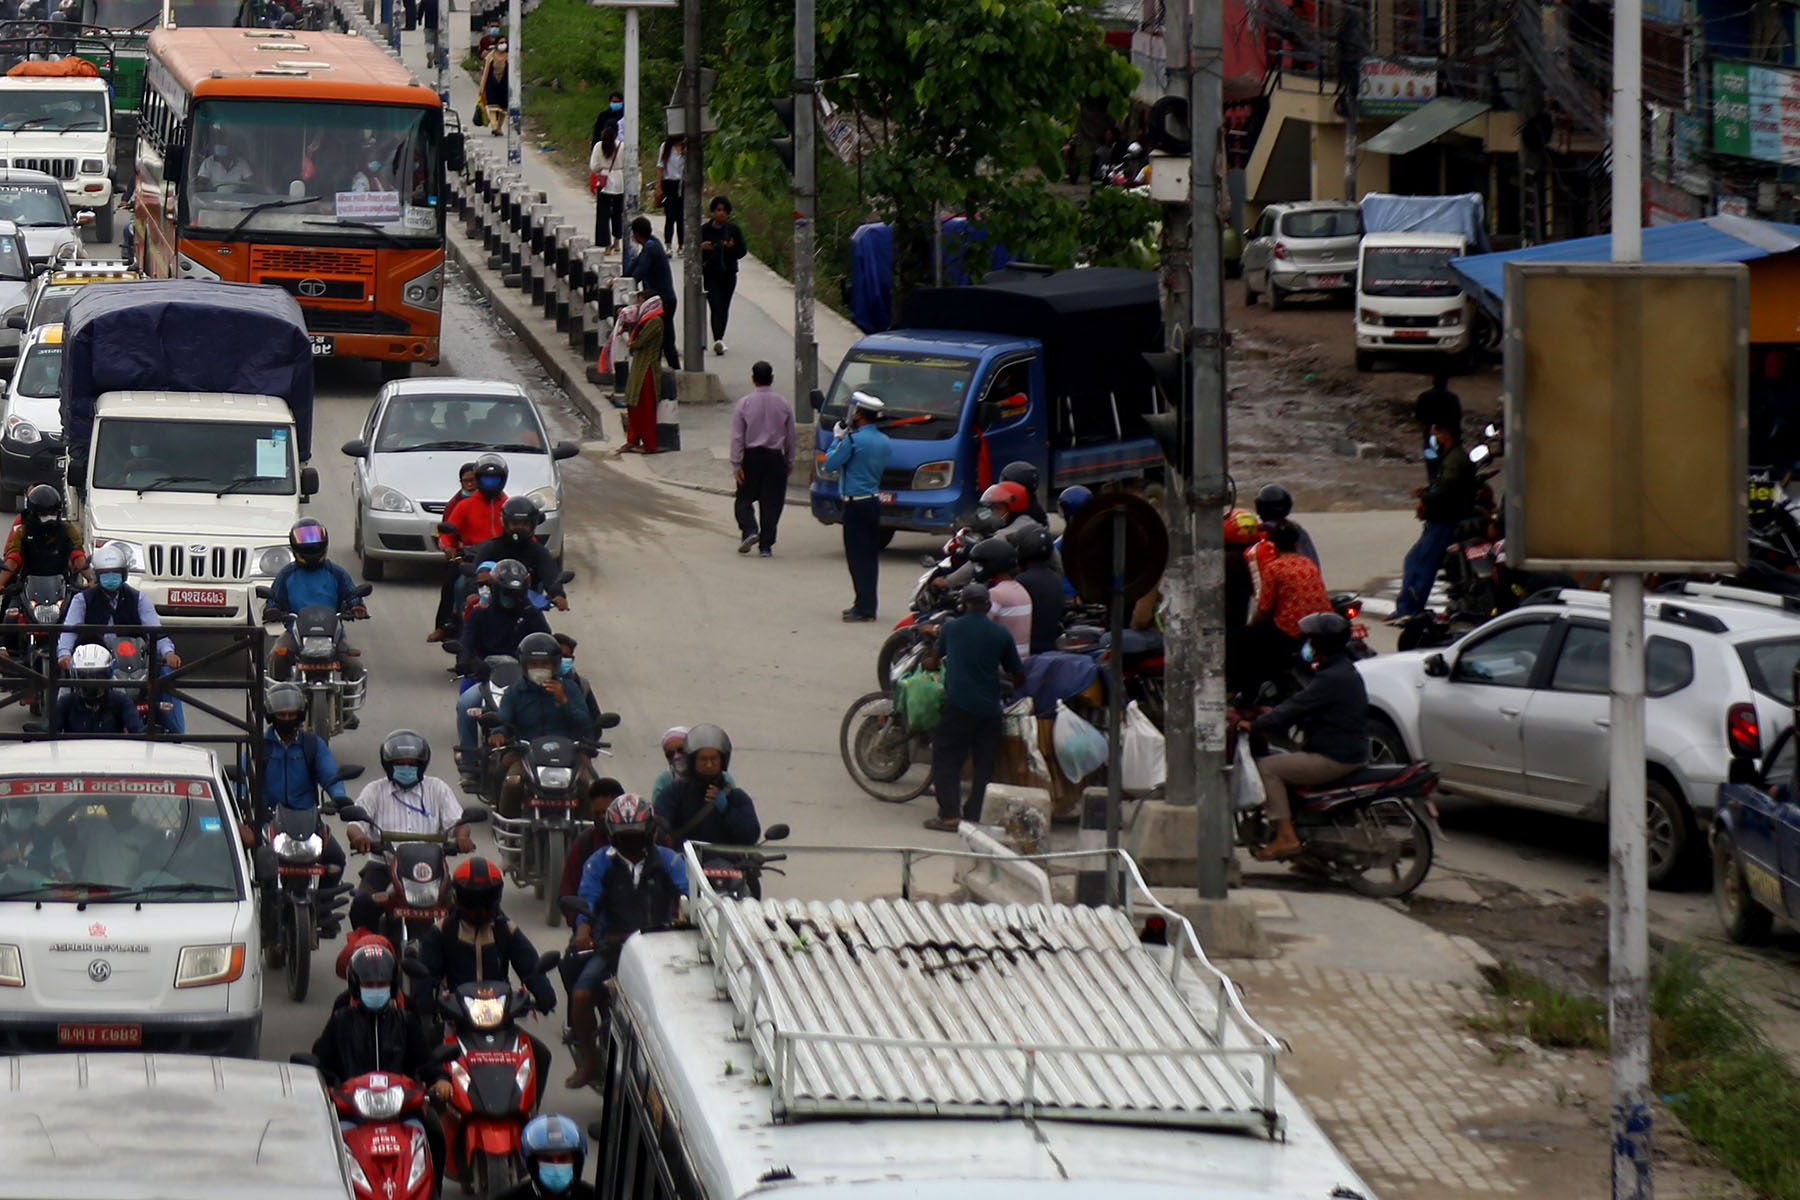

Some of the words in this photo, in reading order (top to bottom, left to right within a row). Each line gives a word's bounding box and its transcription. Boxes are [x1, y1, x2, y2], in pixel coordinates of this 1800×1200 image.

[23, 781, 58, 793] जय
[62, 778, 85, 793] श्री
[48, 943, 93, 953] ASHOK
